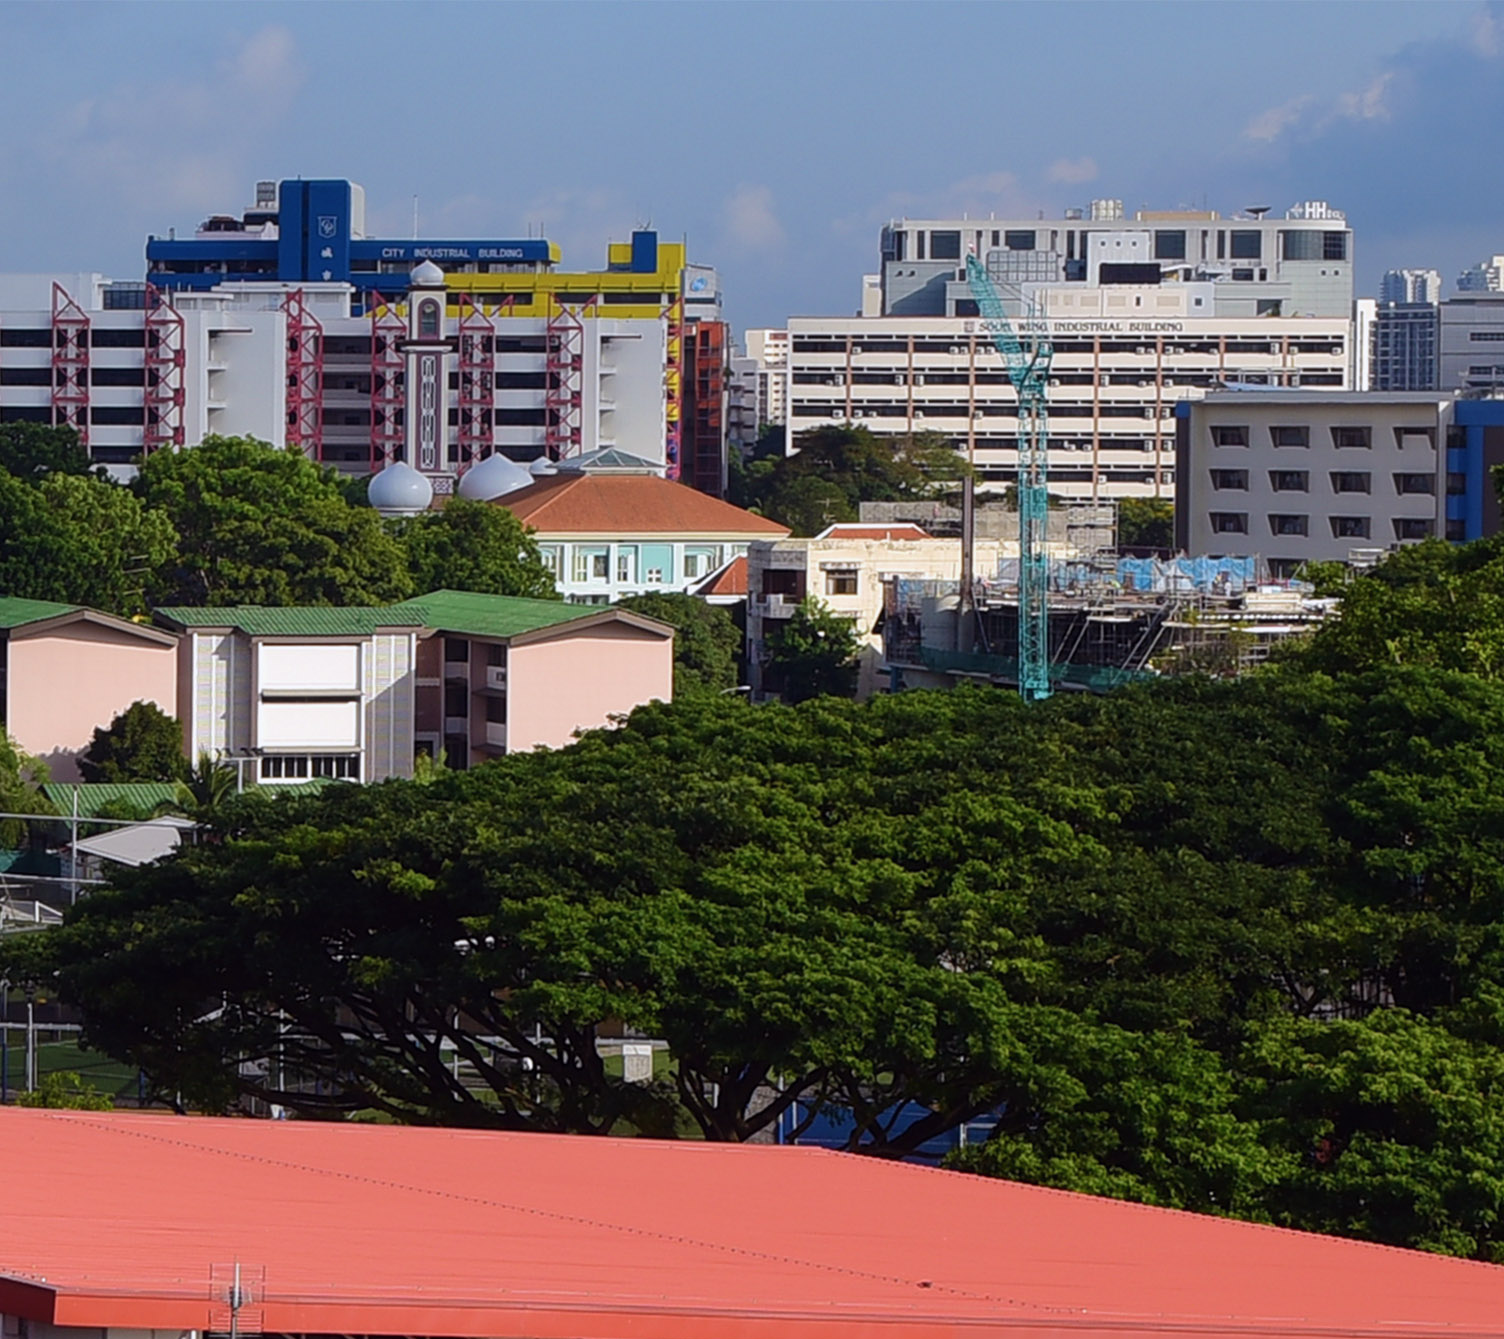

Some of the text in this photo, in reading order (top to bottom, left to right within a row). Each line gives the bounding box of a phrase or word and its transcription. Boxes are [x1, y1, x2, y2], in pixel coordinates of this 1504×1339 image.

[381, 247, 524, 259] CITY INDUSTRIAL BUILDING
[1017, 321, 1049, 333] WING
[1053, 321, 1124, 333] INDUSTRIAL
[1128, 321, 1184, 333] BUILDING
